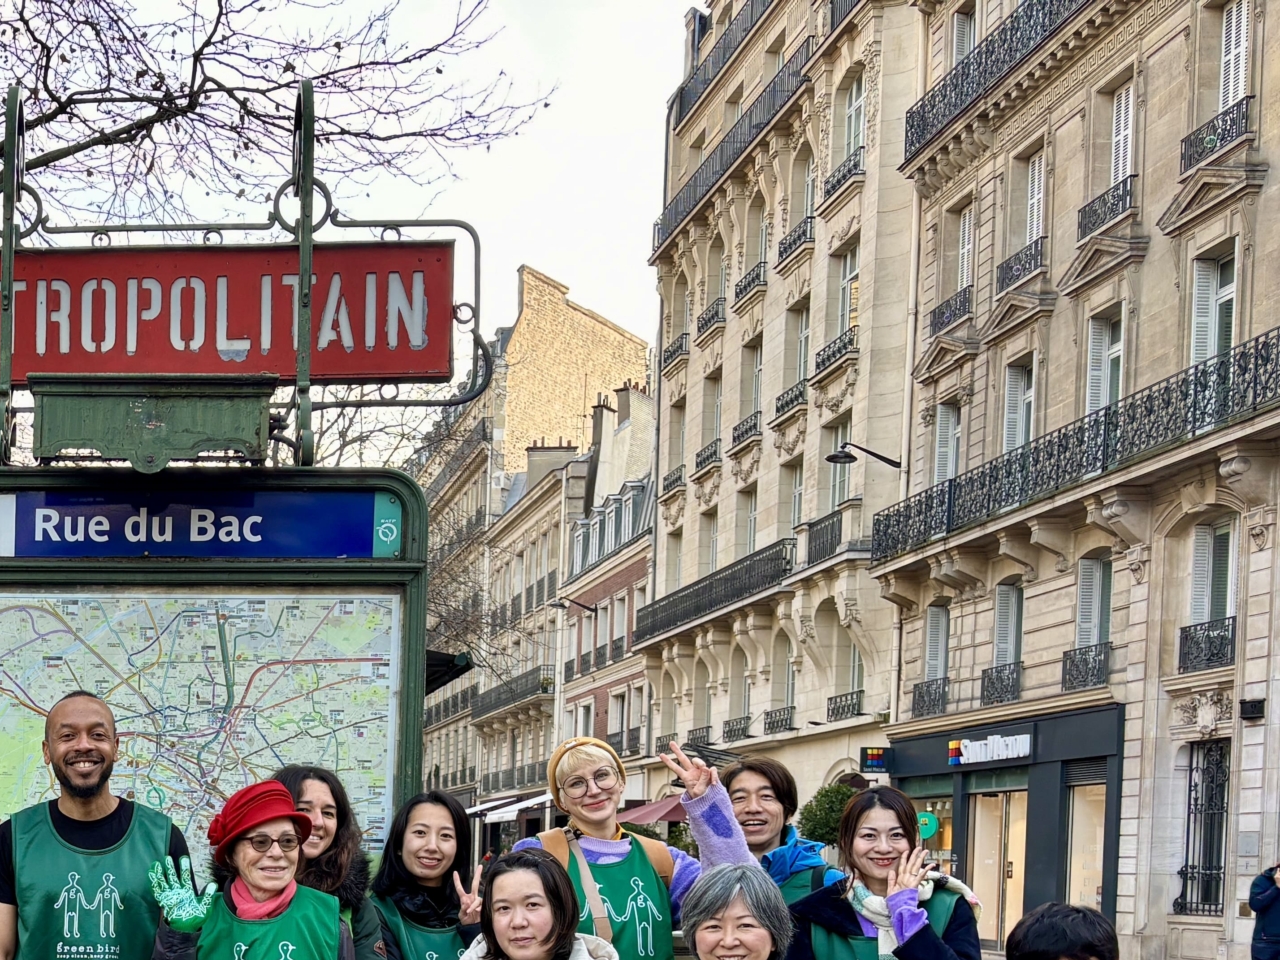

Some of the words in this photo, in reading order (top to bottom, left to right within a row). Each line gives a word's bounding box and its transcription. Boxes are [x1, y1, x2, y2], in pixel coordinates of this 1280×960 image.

[34, 507, 111, 542] Rue
[124, 507, 173, 543] du
[189, 508, 263, 542] Bac
[637, 894, 646, 908] g
[56, 942, 94, 953] green
[97, 944, 120, 953] bird
